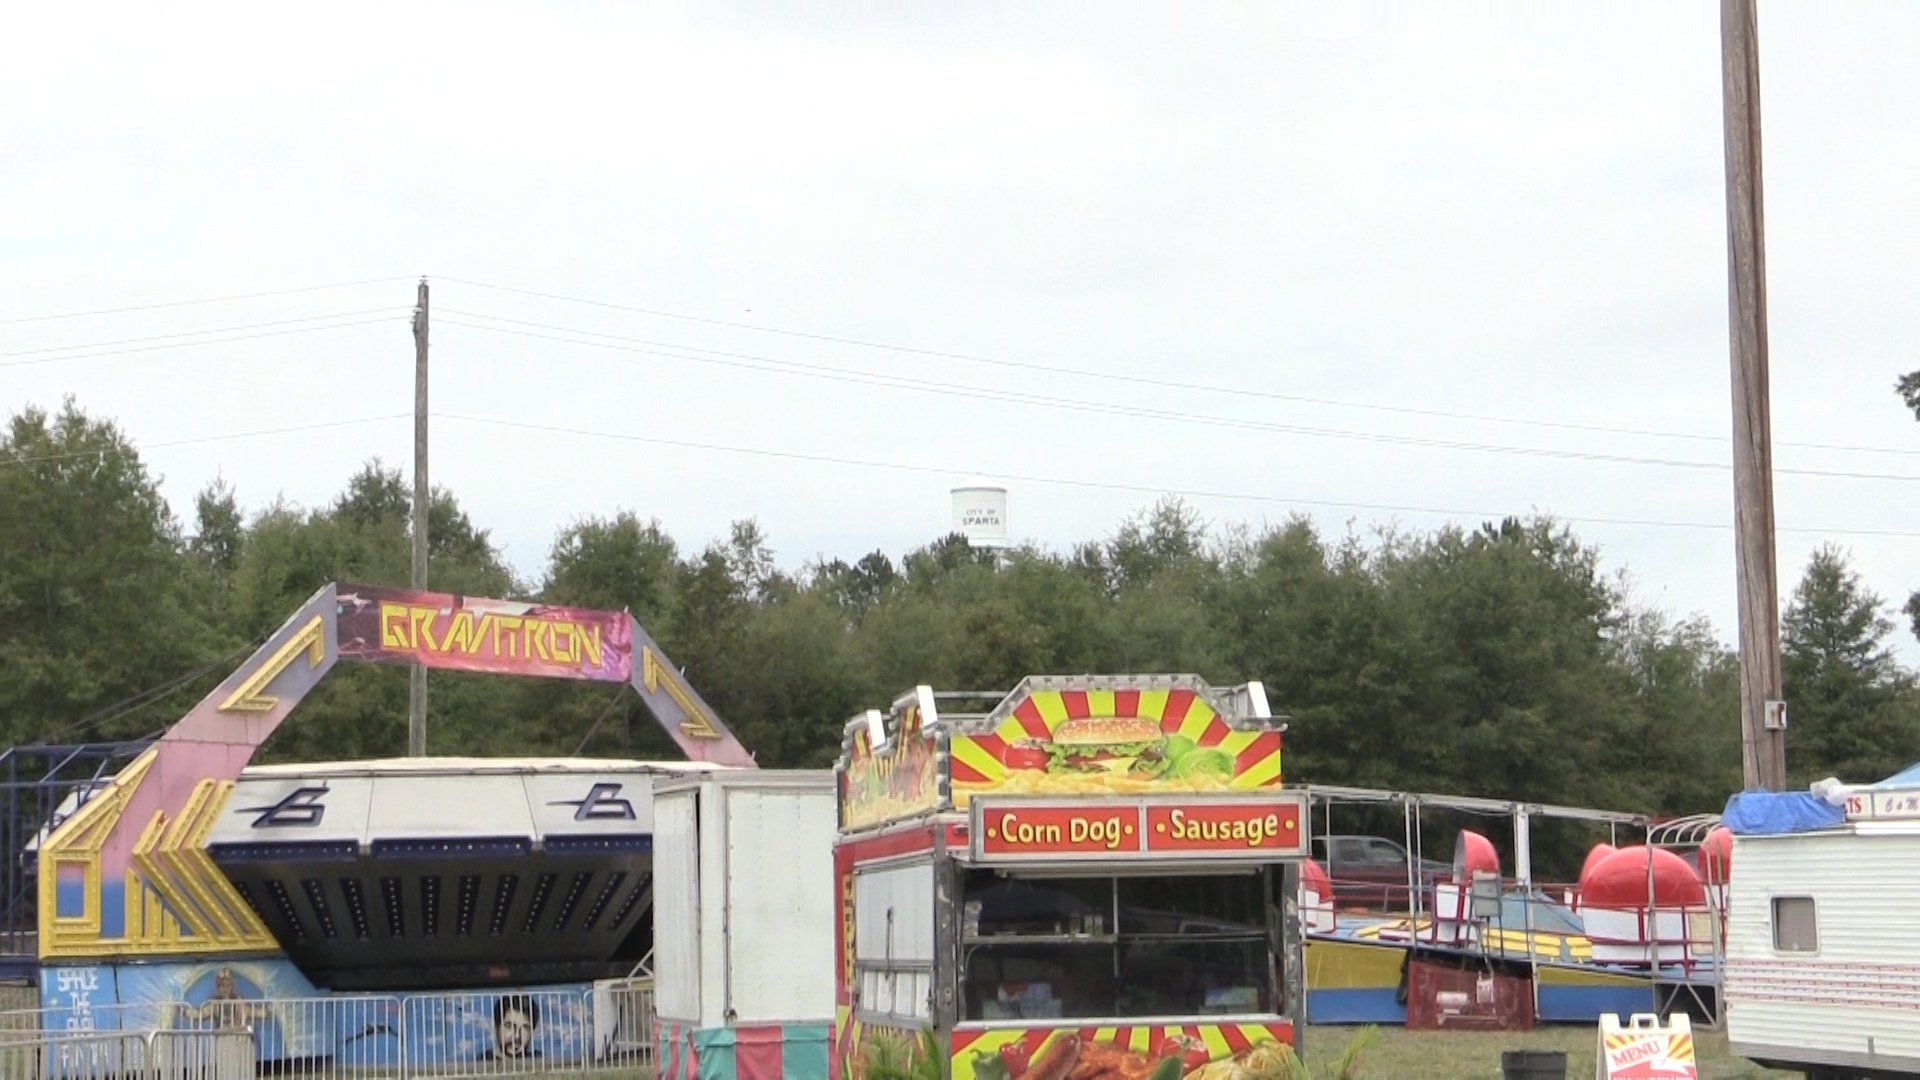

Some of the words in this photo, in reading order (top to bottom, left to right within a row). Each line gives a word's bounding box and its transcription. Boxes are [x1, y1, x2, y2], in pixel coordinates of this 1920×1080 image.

[962, 517, 1000, 526] SPARTA
[380, 600, 602, 666] GRAVITRON
[1001, 813, 1061, 844] Corn
[1070, 815, 1121, 849] Dog
[1170, 808, 1278, 847] Sausage
[1611, 1040, 1661, 1067] MENU
